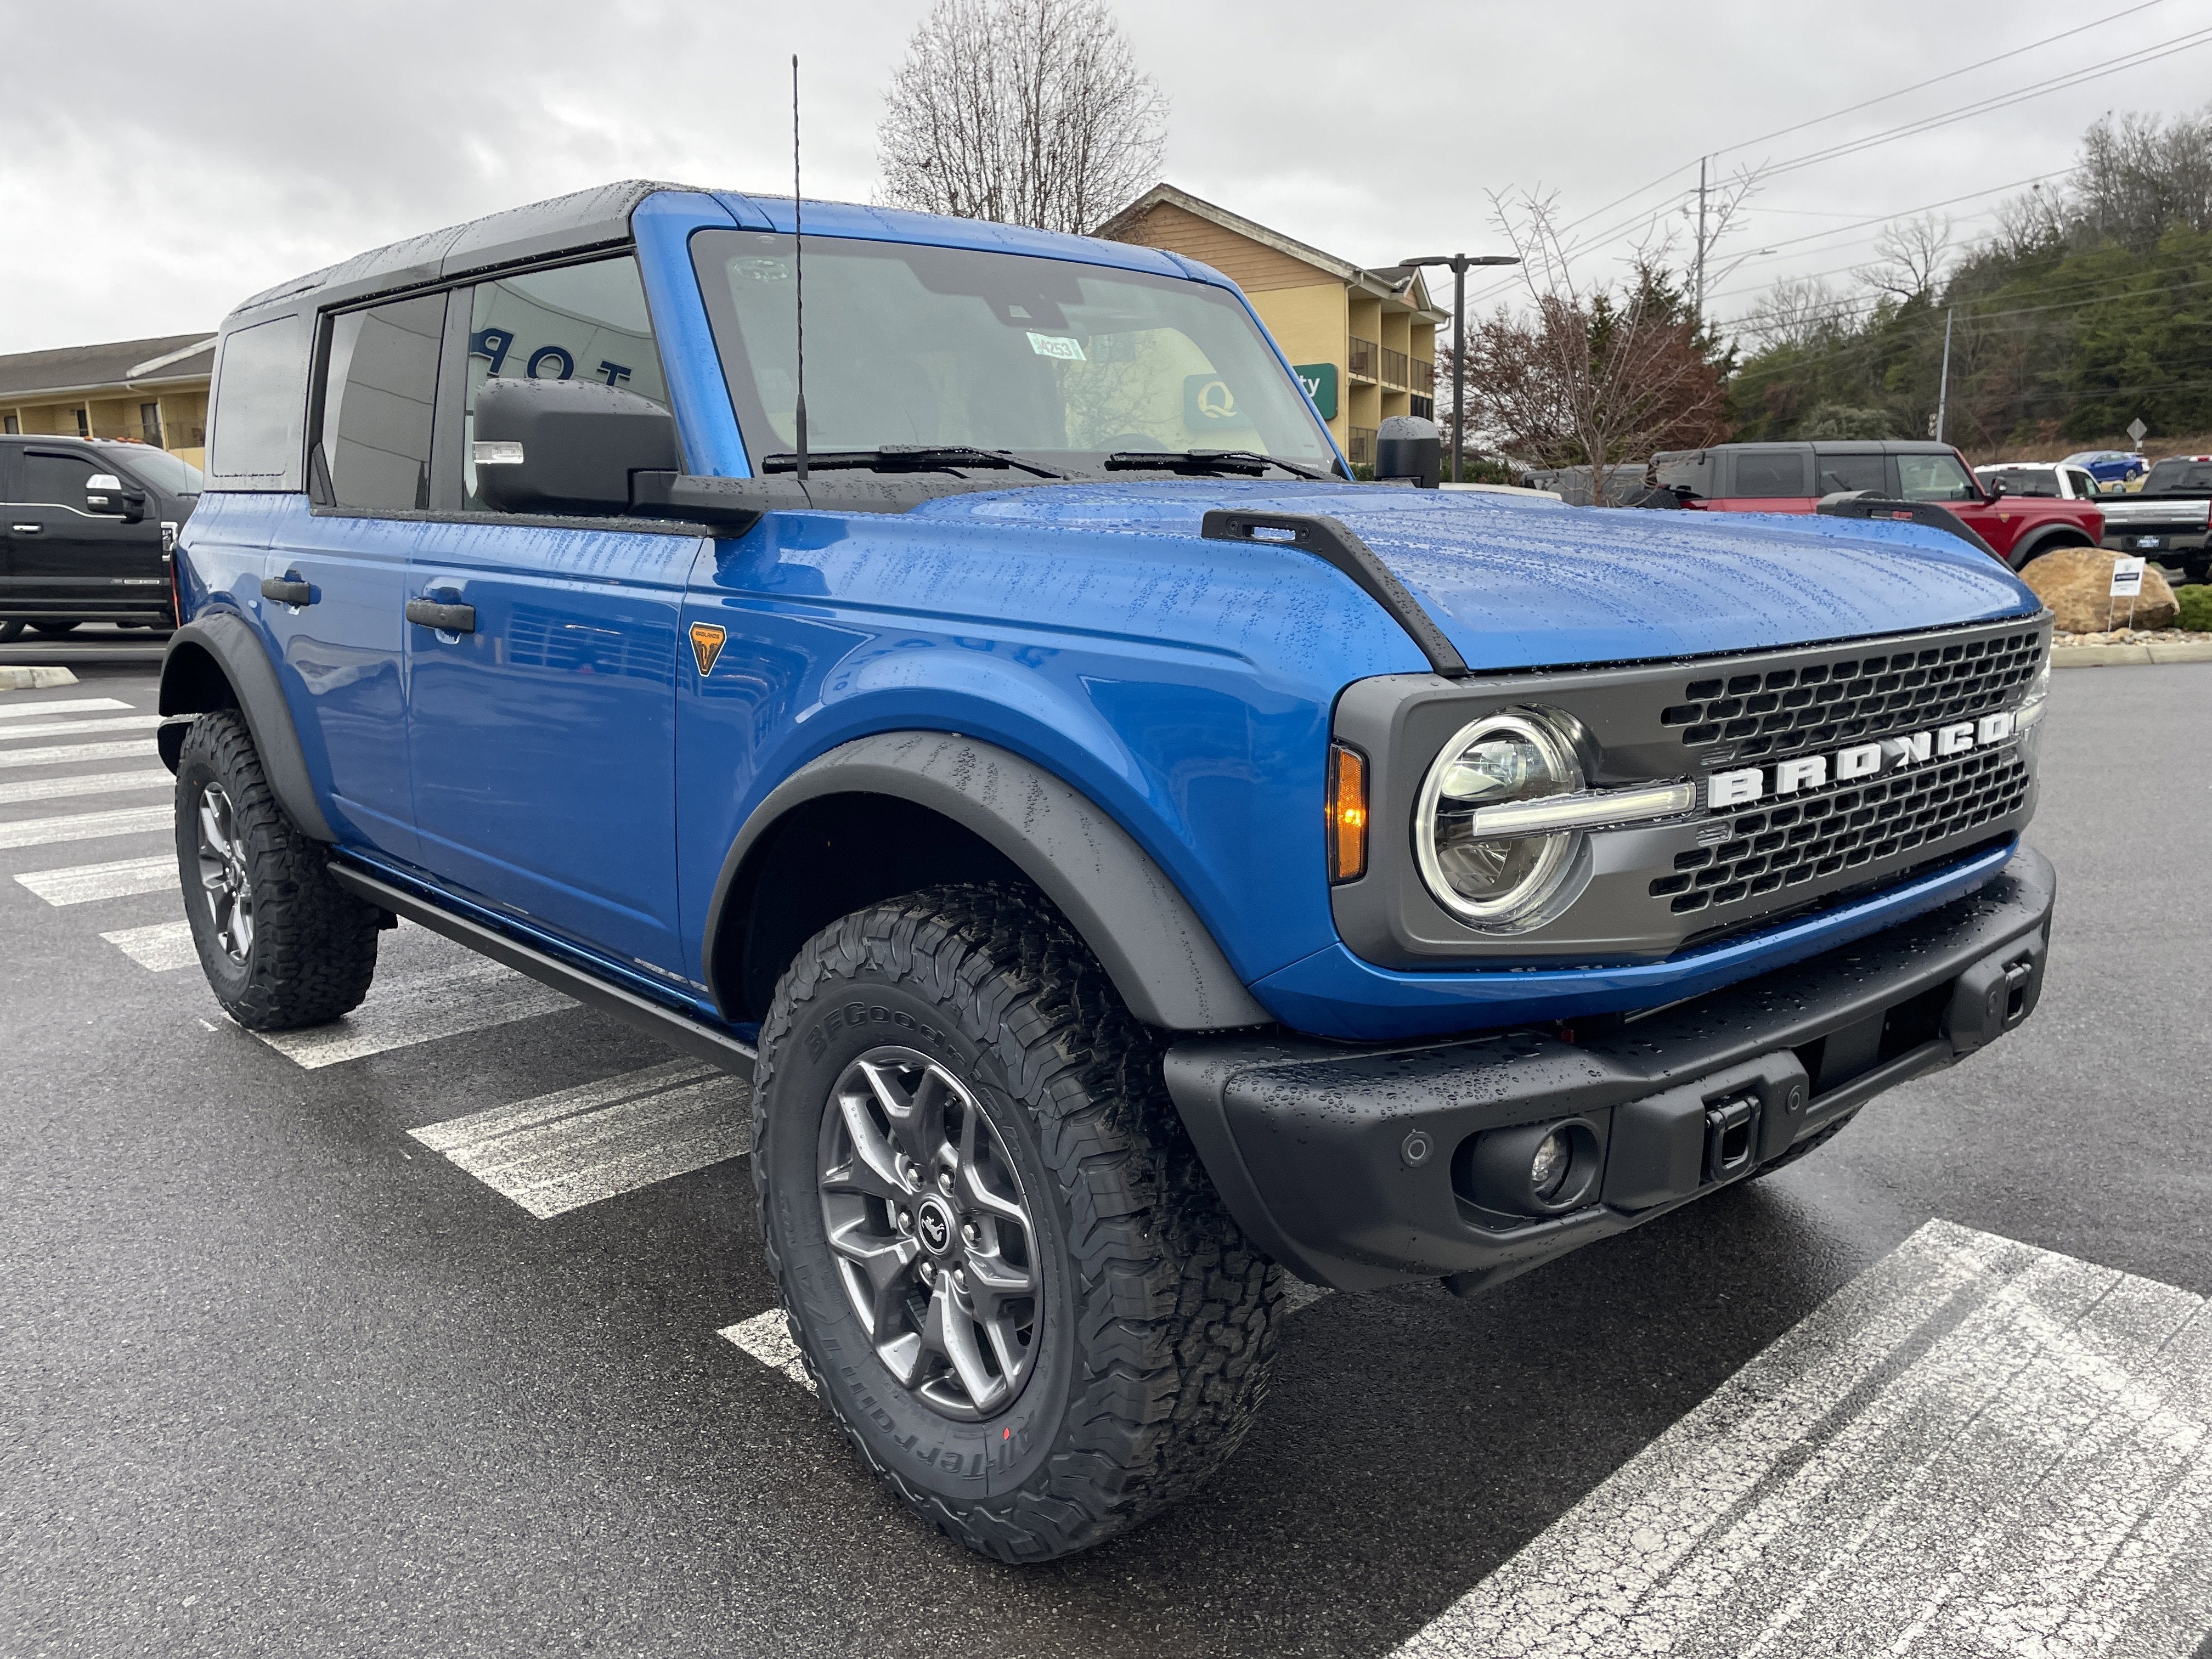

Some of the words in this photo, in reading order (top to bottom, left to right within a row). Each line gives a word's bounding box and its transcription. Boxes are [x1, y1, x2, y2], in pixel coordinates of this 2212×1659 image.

[1041, 339, 1073, 356] 4253
[1198, 381, 1237, 418] Q
[696, 631, 720, 639] BADLANDS
[1707, 713, 2010, 809] BRONCO
